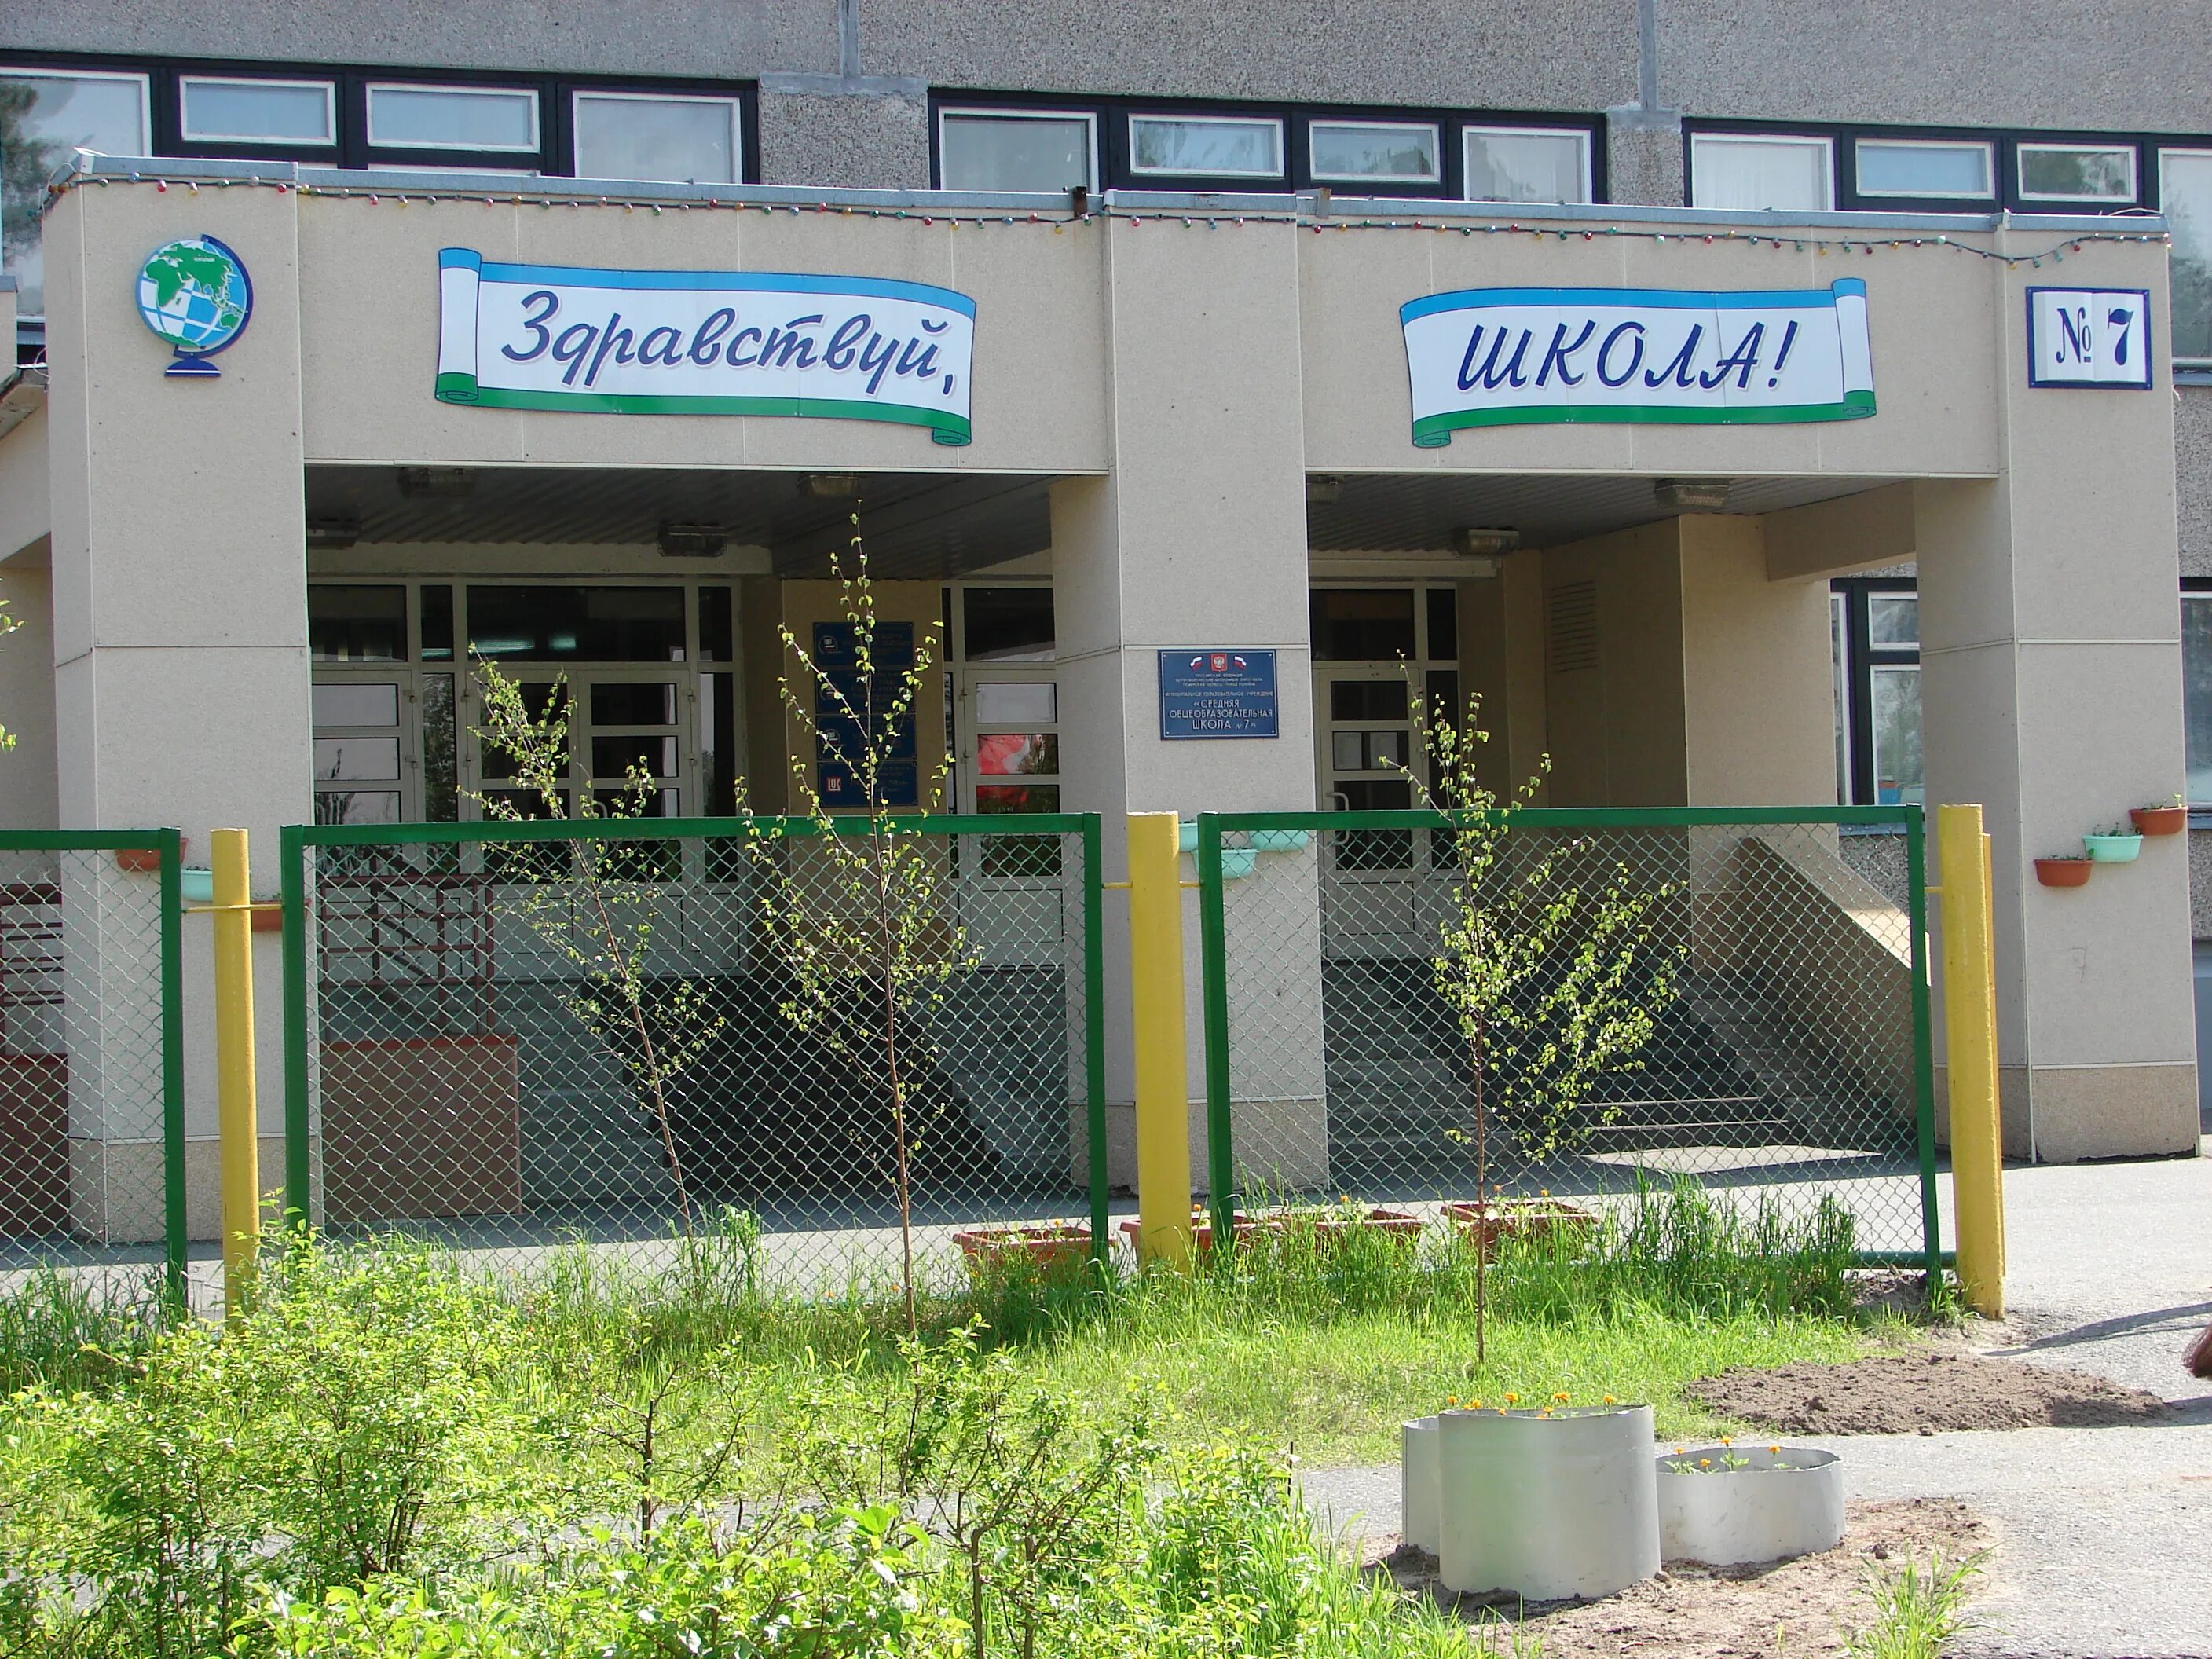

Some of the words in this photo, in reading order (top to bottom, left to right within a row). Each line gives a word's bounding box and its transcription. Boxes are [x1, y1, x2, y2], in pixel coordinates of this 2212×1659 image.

[501, 289, 954, 396] Здравствуй,
[1456, 319, 1799, 390] ШКОЛА!
[2108, 308, 2134, 366] 7
[1169, 709, 1273, 719] ОБЩЕОБРАЗОВАТЕЛЬНАЯ
[1192, 719, 1232, 730] ШКОЛА
